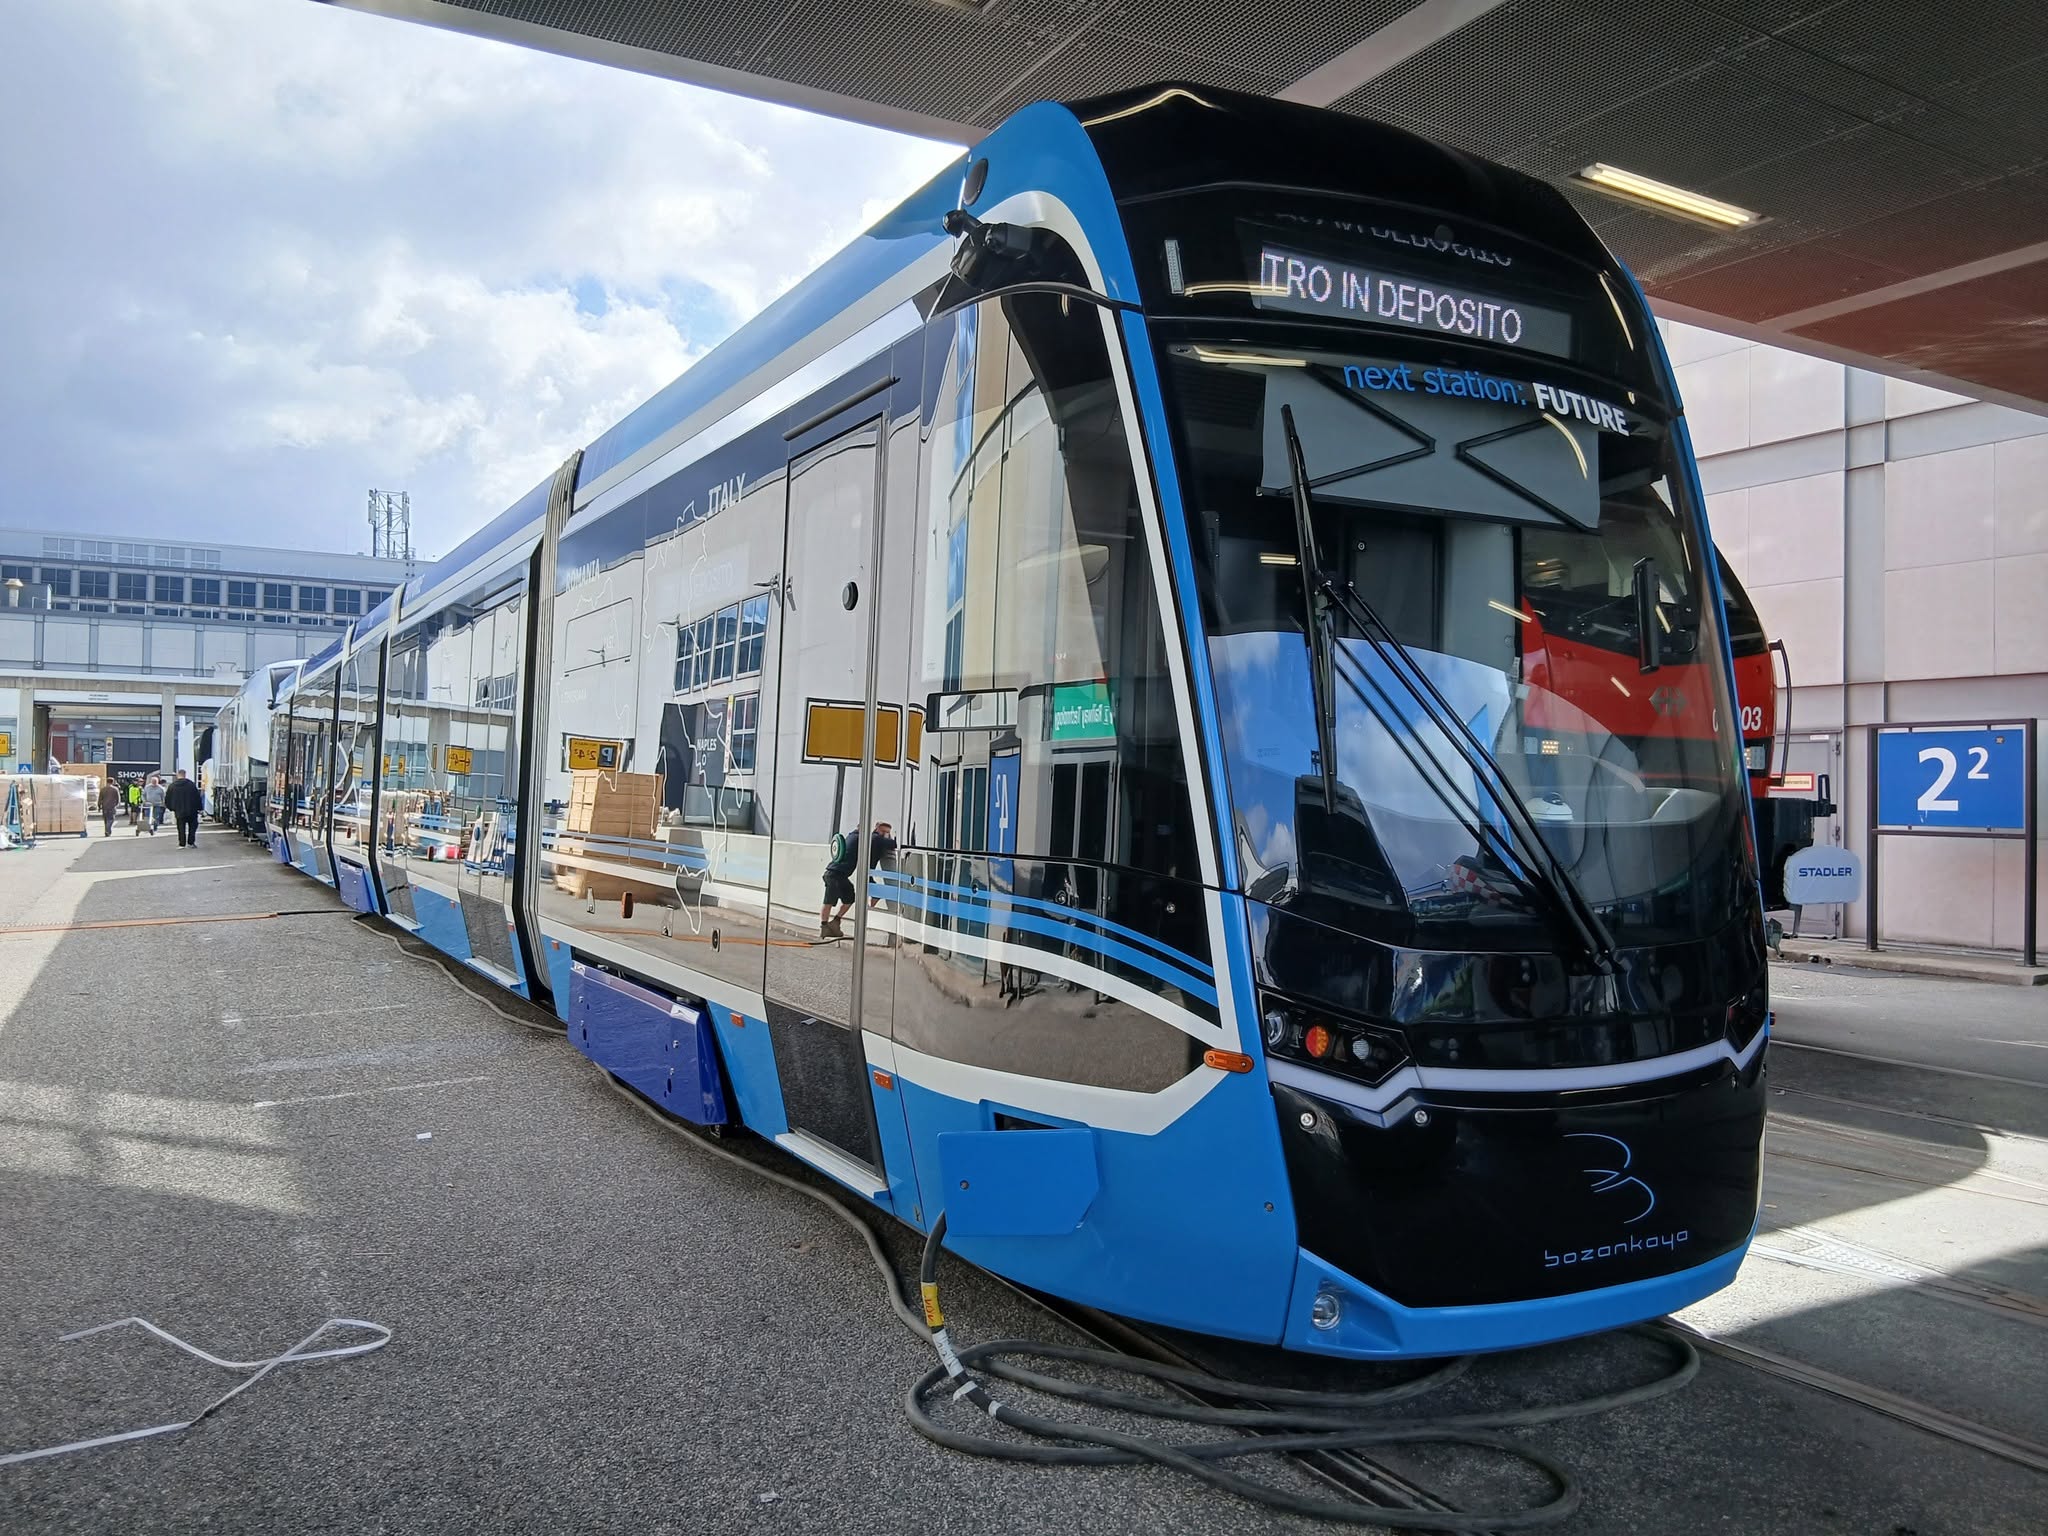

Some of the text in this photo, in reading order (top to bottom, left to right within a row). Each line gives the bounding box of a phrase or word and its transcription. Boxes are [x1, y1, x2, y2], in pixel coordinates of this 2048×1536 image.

[1261, 252, 1522, 344] TRO IN DEPOSITO
[1343, 362, 1416, 392] next
[1532, 382, 1631, 437] FUTURE
[708, 472, 746, 518] ITALY
[696, 738, 717, 751] NAPLES
[1798, 867, 1853, 877] STADLER
[1545, 1230, 1689, 1268] bozankaya
